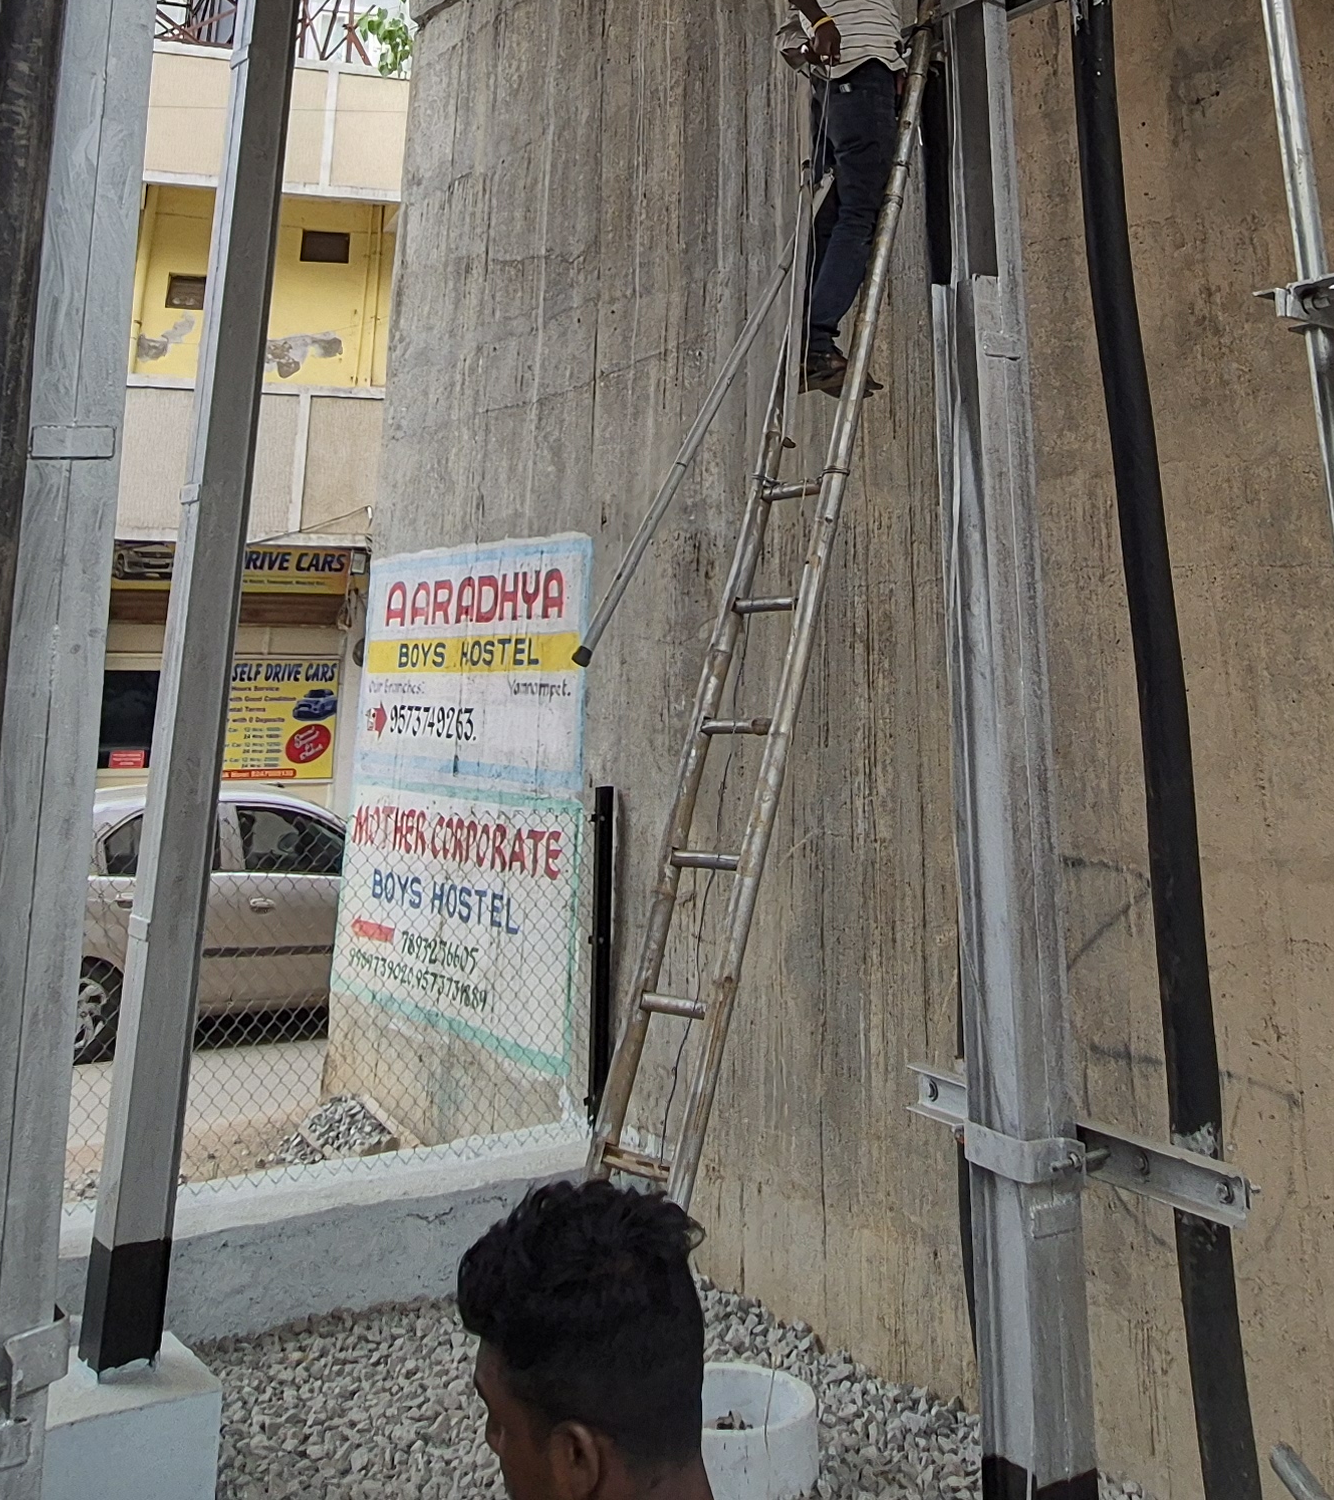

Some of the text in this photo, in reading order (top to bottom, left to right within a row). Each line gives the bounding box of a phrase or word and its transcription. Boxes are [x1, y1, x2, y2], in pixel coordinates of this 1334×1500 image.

[245, 550, 346, 572] RIVE CARS
[385, 568, 564, 627] AARADHYA
[232, 663, 338, 682] SELF DRIVE CARS
[398, 637, 539, 668] BOYS HOSTEL
[351, 805, 564, 881] MOTHER CORPORATE
[371, 868, 522, 935] BOYS HOSTEL
